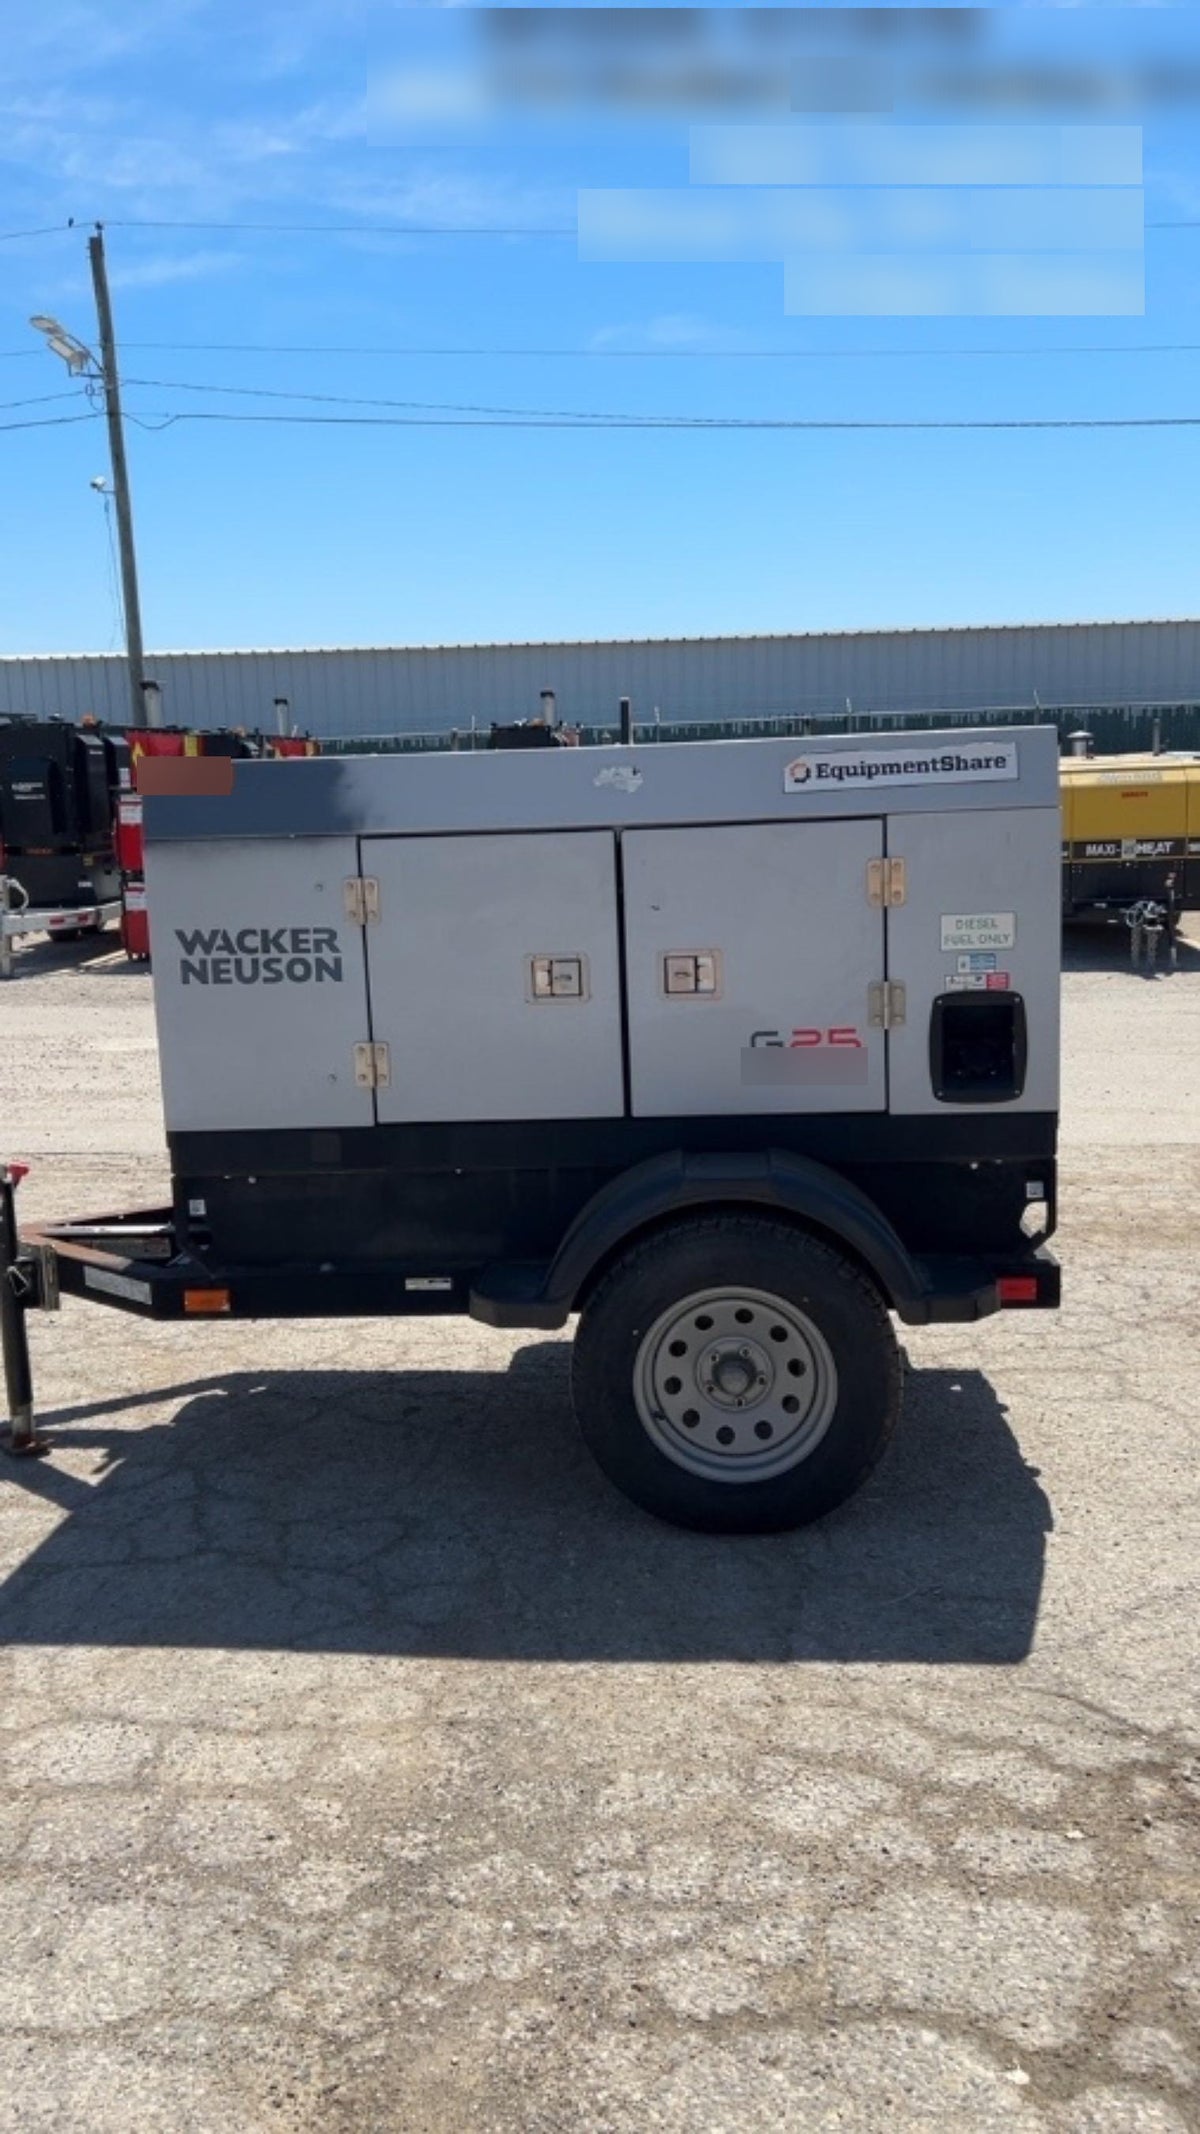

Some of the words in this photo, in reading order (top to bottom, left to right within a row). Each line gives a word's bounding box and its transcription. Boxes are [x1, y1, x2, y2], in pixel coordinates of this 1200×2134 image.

[816, 756, 1007, 780] EquipmentShare
[955, 918, 999, 930] DIESEL
[174, 927, 342, 956] WACKER
[944, 934, 975, 947] FUEL
[978, 933, 1011, 945] ONLY
[180, 956, 343, 985] NEUSON
